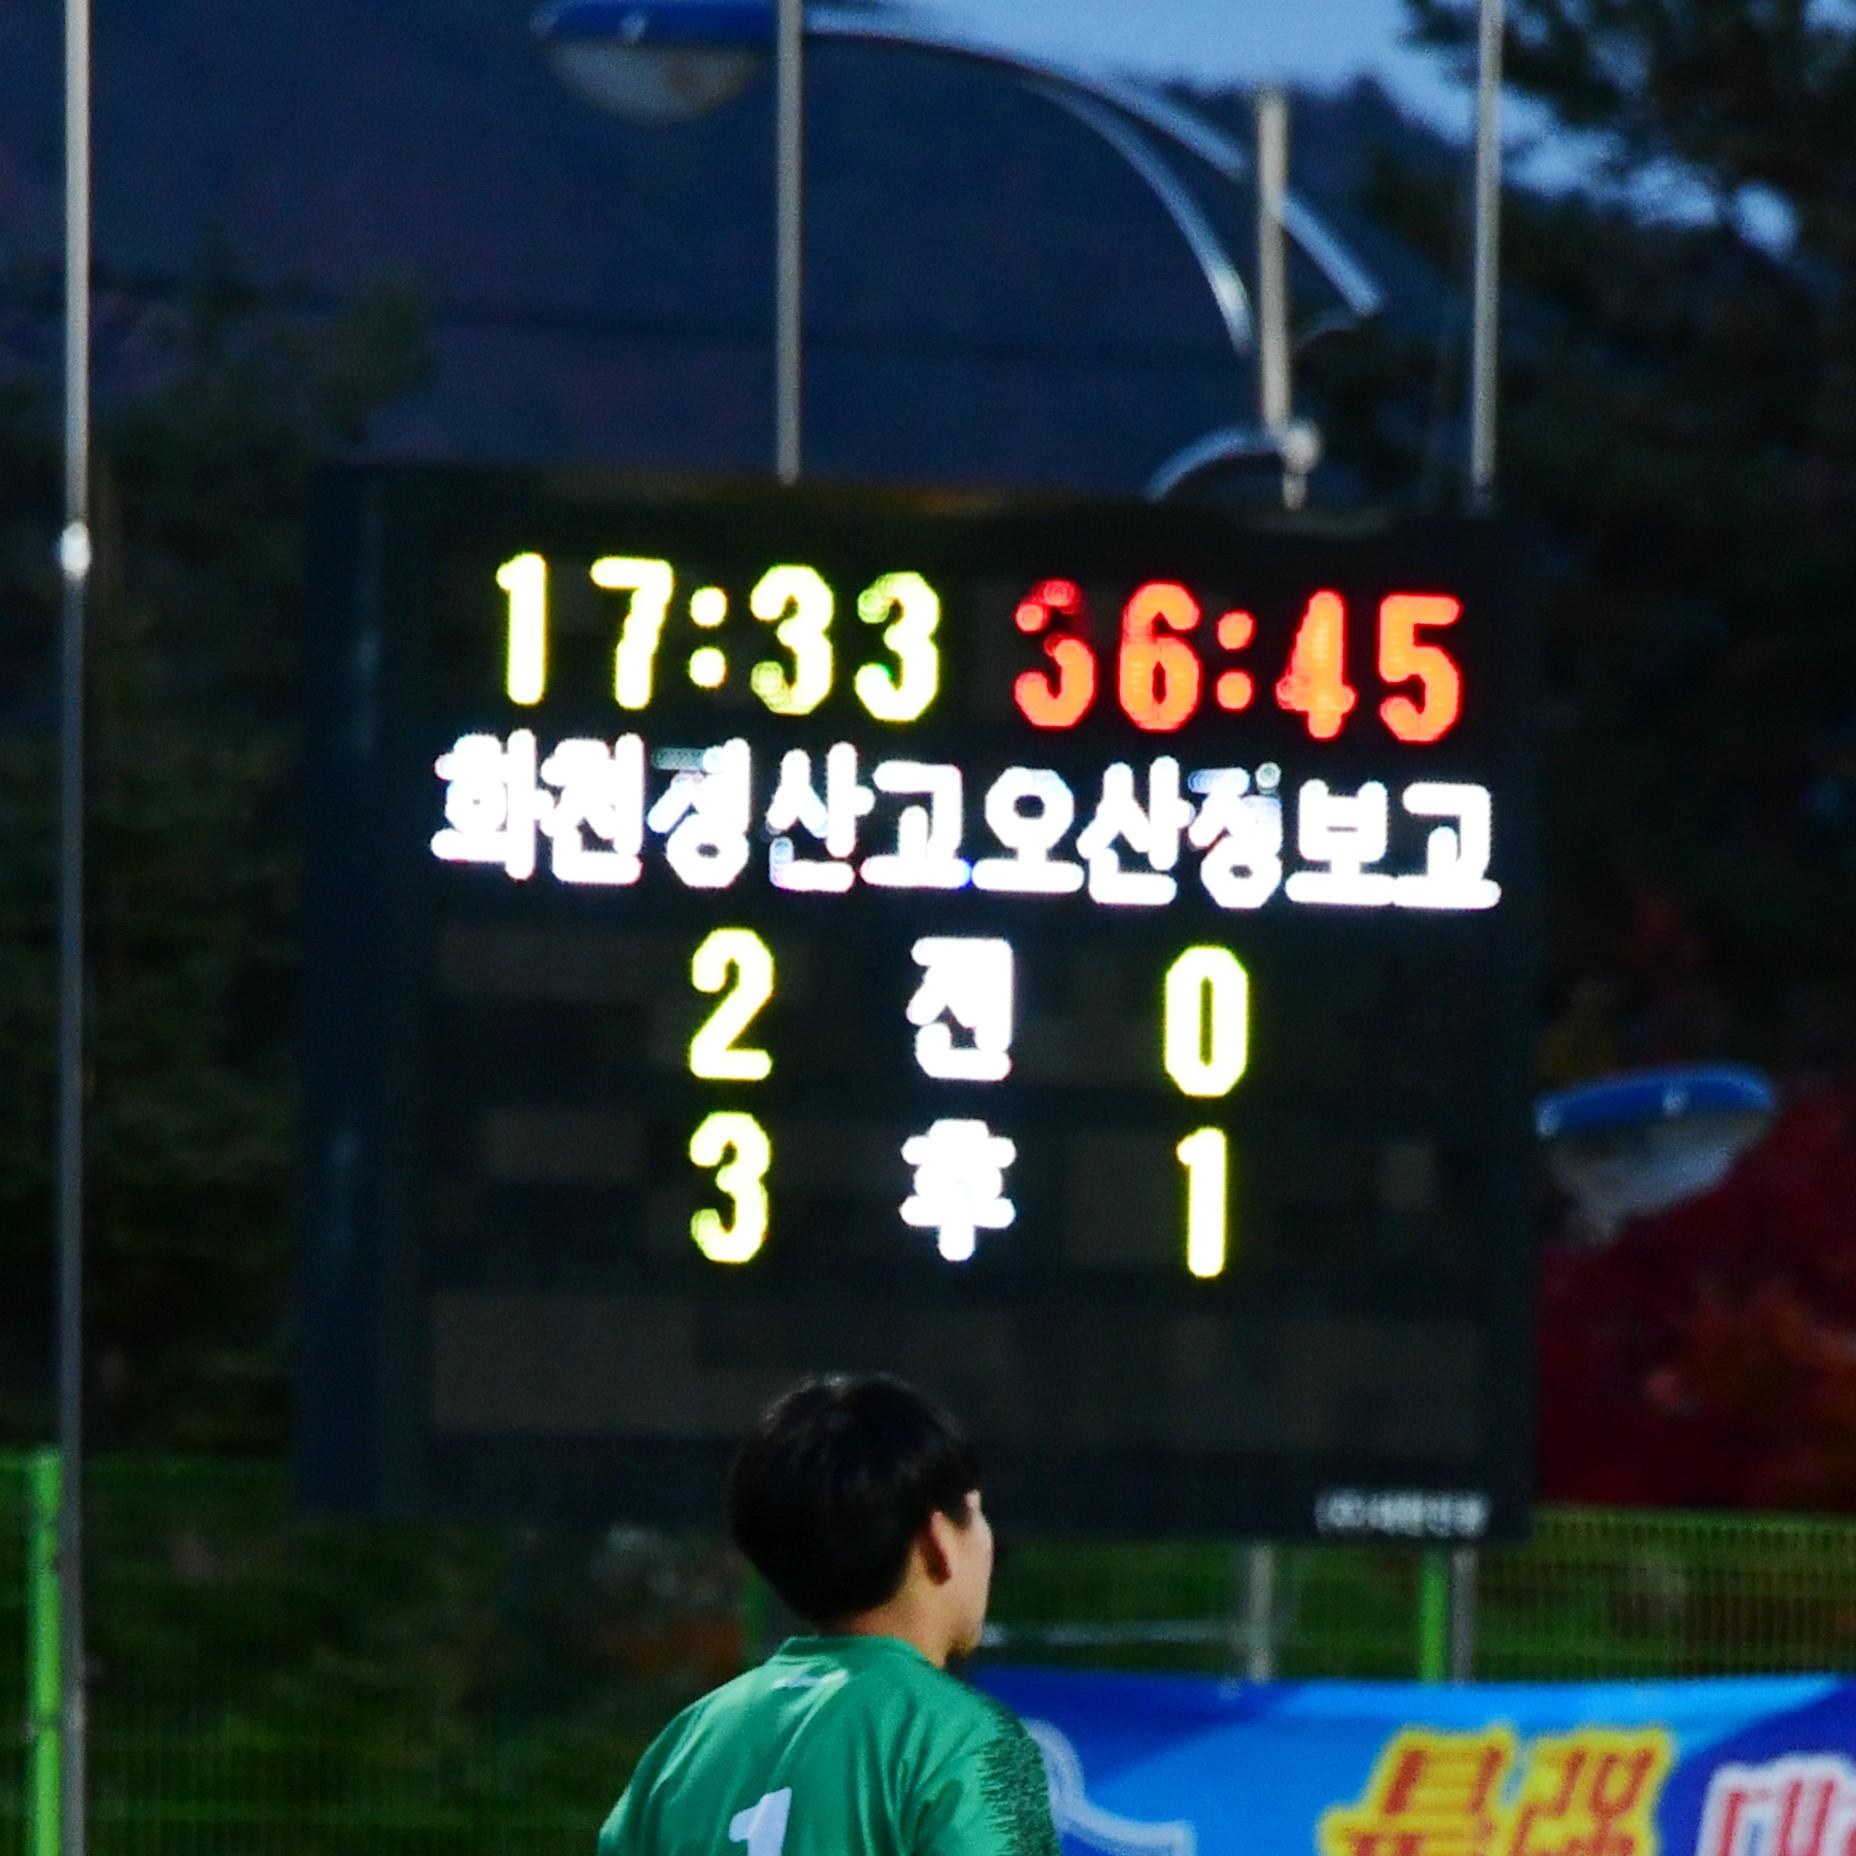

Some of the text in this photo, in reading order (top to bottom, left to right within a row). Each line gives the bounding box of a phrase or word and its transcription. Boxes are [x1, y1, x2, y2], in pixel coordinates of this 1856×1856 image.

[496, 552, 941, 723] 17:33
[688, 928, 1249, 1098] 2 전 0
[689, 1111, 1228, 1278] 3 후 1
